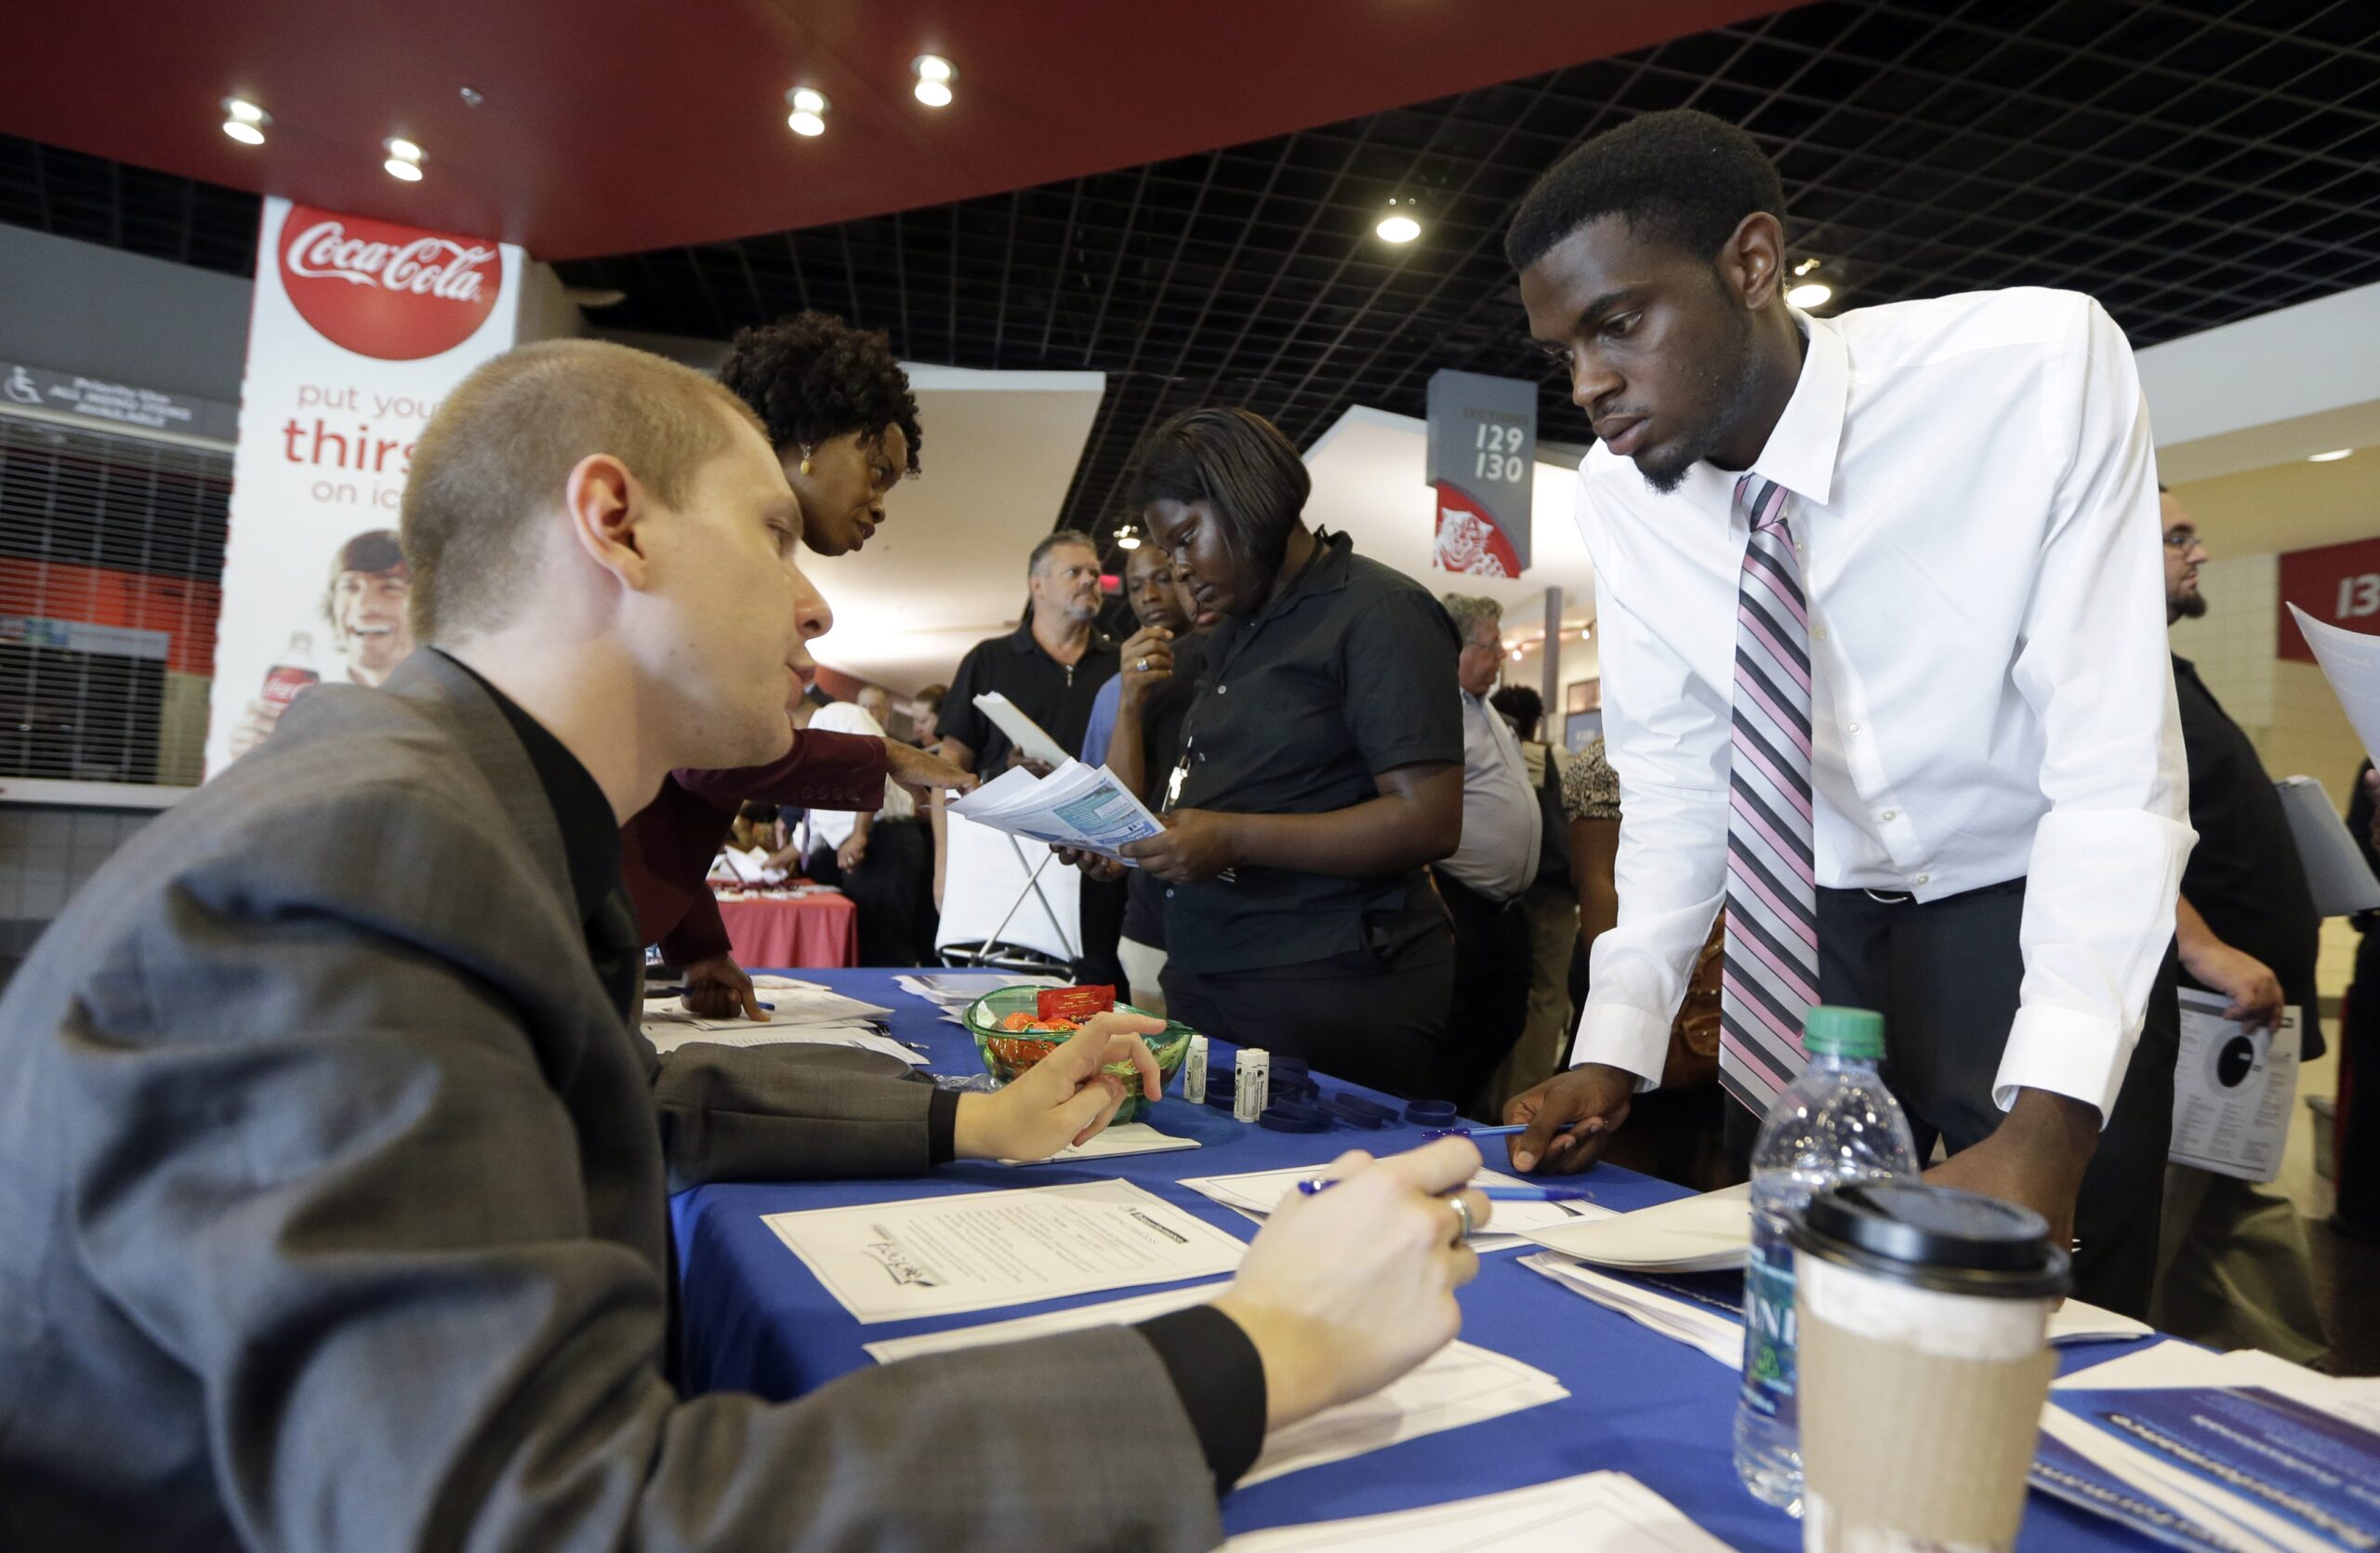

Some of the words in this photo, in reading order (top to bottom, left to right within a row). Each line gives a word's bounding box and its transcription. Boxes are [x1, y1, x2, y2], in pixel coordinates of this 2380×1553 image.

[286, 220, 496, 301] Coca-Cola
[298, 384, 359, 411] put
[374, 393, 443, 419] you
[283, 418, 418, 475] thirs
[1475, 423, 1524, 454] 129
[1475, 452, 1524, 483] 130
[311, 480, 358, 504] on
[372, 480, 402, 510] ic
[2335, 573, 2380, 619] 13
